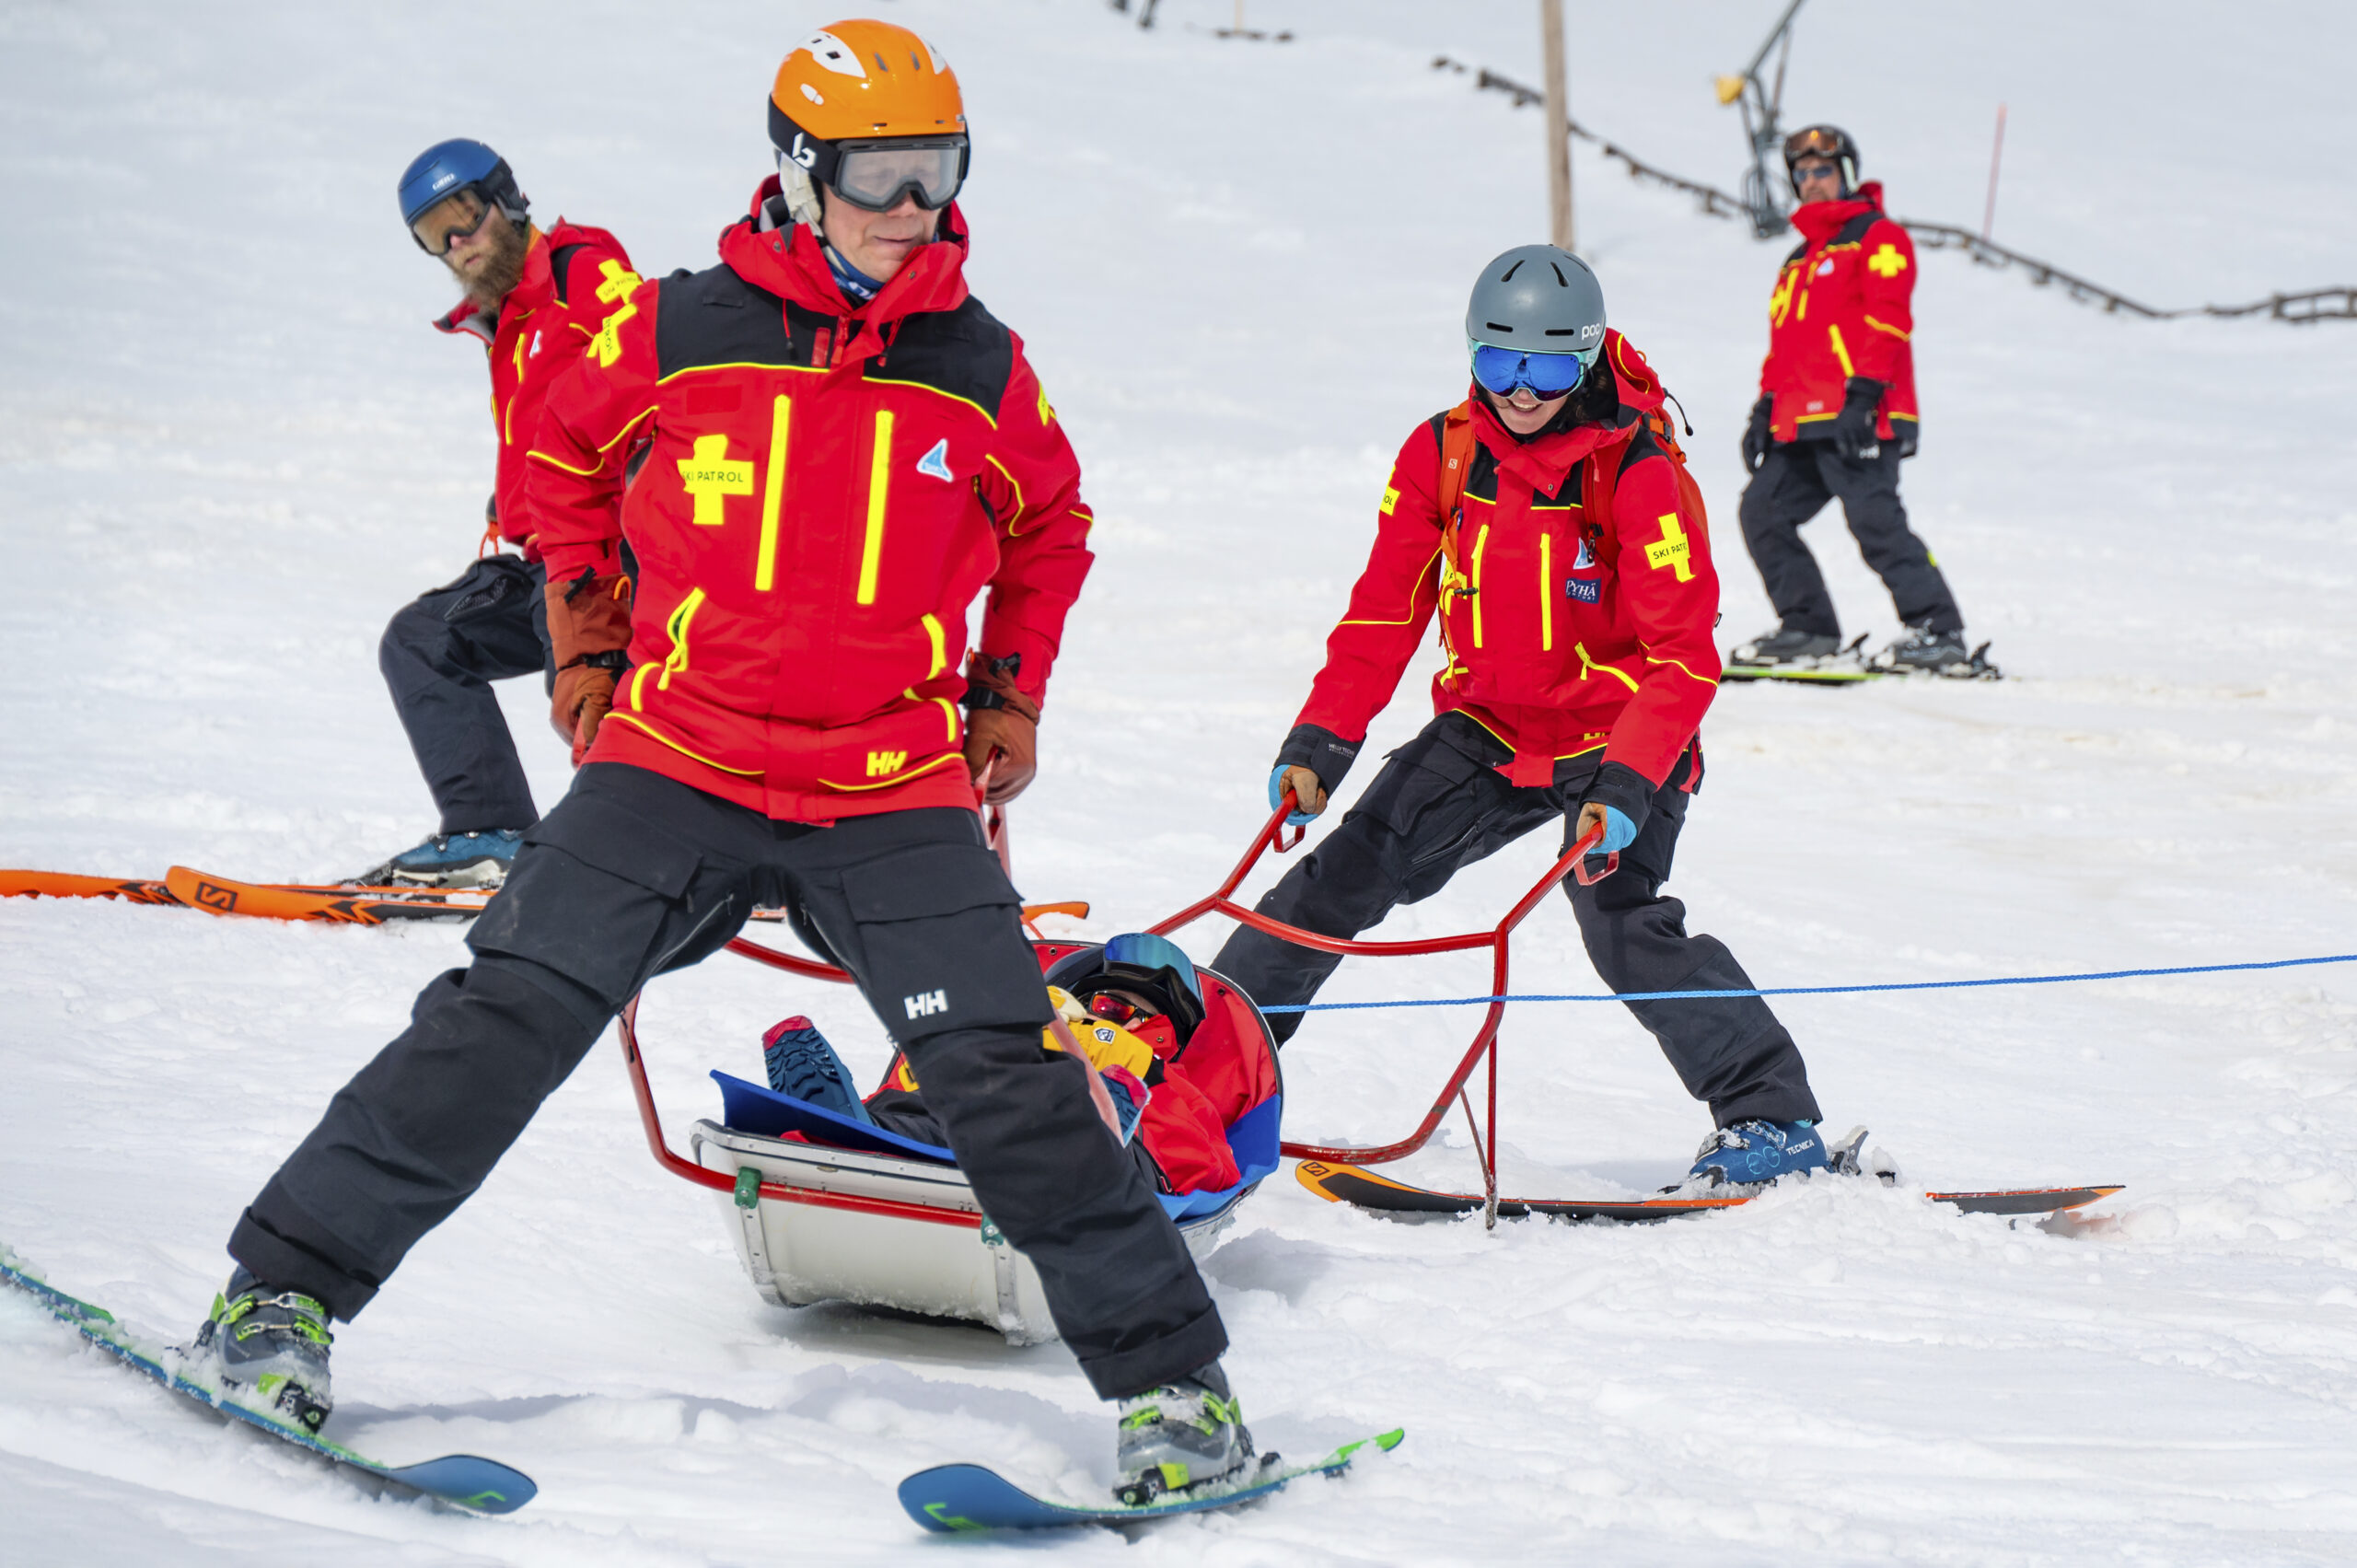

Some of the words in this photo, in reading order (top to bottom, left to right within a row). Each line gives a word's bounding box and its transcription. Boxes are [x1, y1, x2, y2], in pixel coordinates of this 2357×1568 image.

[697, 470, 744, 483] PATROL
[1653, 548, 1669, 560] SKI
[866, 750, 907, 777] HH
[904, 989, 948, 1020] HH
[1785, 1139, 1815, 1156] TECNICA
